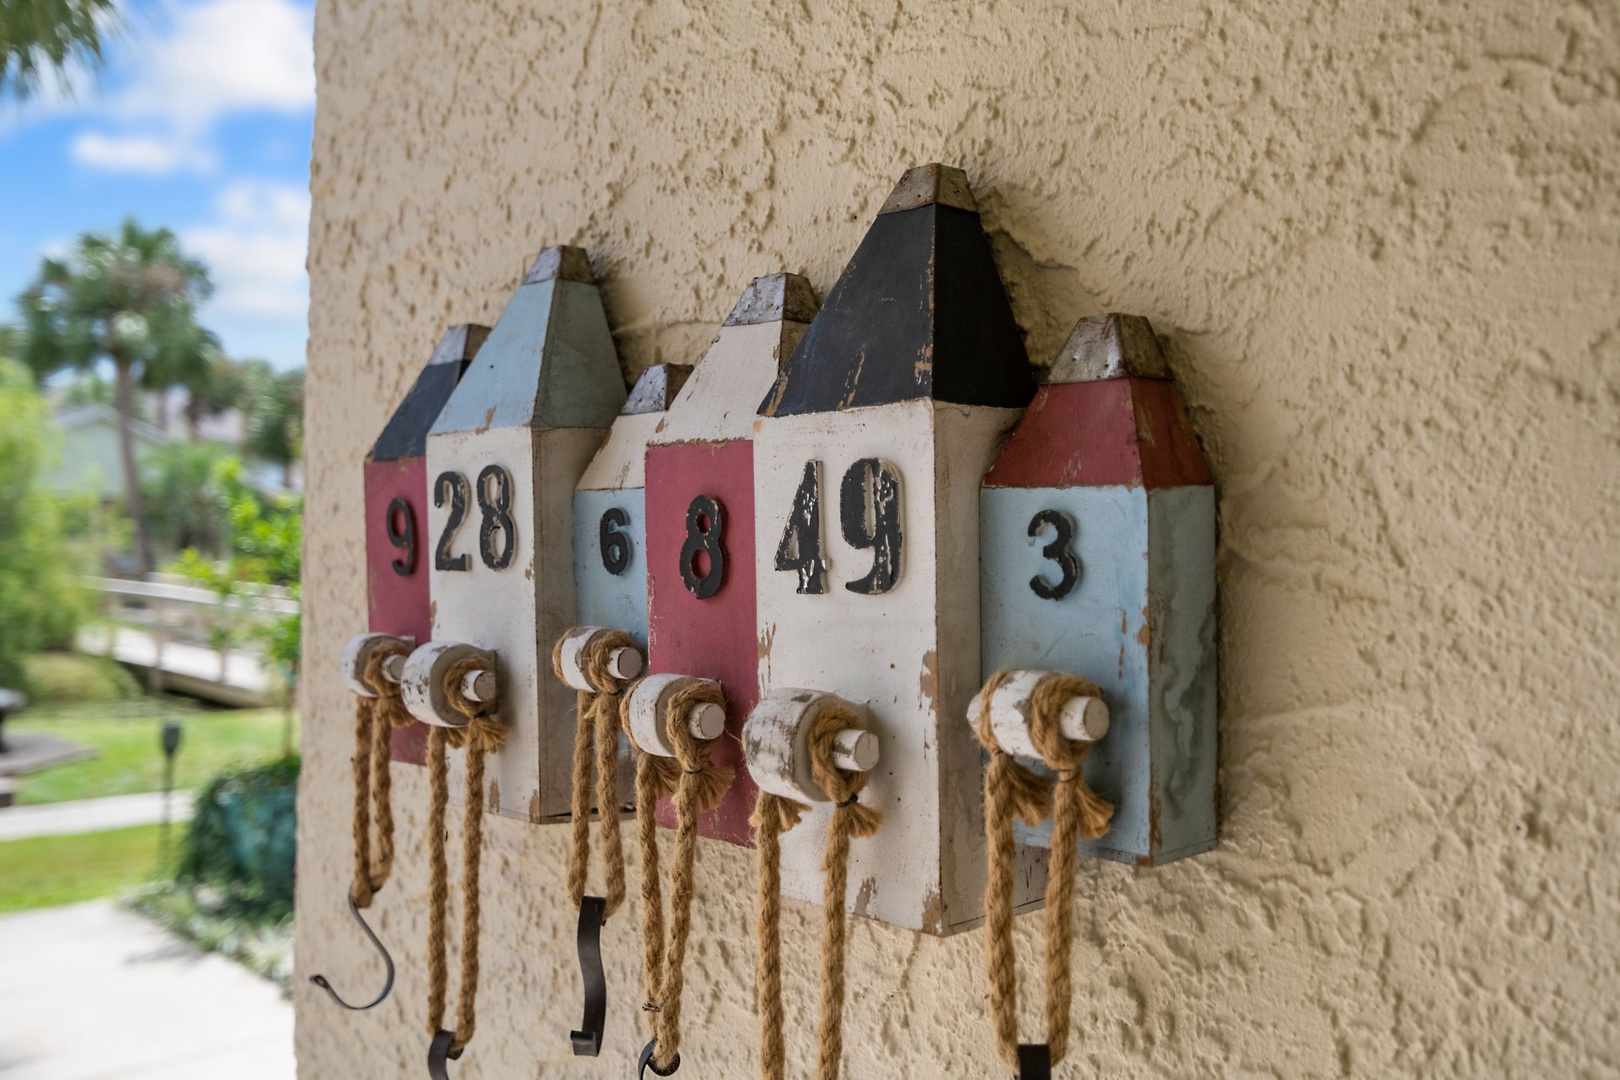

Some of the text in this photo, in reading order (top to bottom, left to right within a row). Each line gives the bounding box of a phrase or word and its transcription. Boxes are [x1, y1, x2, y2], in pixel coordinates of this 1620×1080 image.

[386, 497, 414, 576] 9
[434, 464, 520, 572] 28
[599, 507, 634, 576] 6
[679, 494, 725, 600] 8
[774, 457, 906, 595] 49
[1027, 508, 1082, 601] 3
